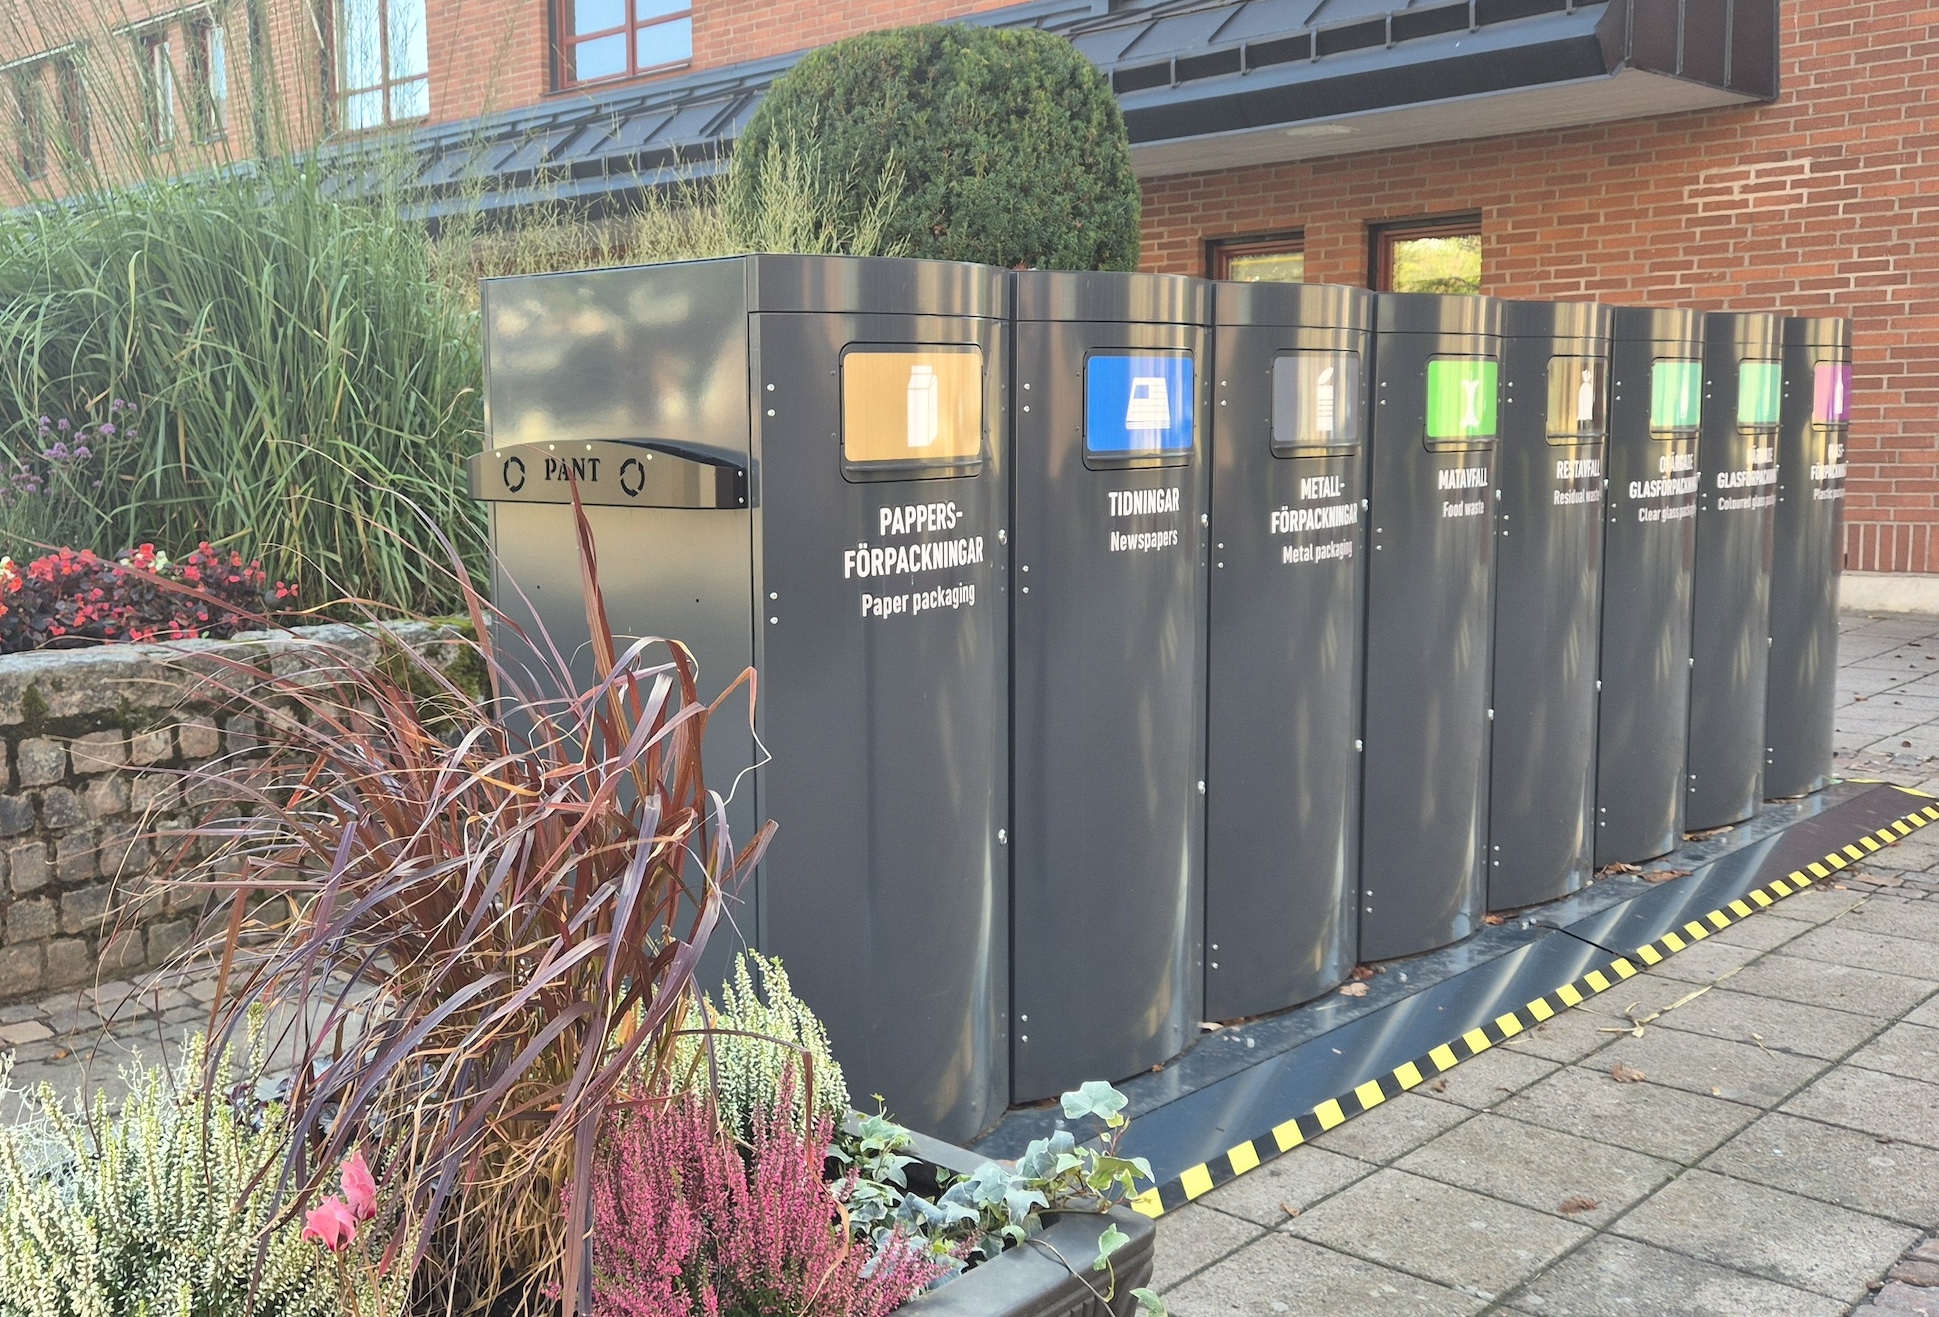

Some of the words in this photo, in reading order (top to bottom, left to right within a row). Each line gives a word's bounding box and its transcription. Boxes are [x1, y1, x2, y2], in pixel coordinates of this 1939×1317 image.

[545, 458, 600, 481] PANT
[1438, 467, 1488, 490] MATAVFALL
[1556, 459, 1600, 479] RESTAVFALL
[1301, 475, 1346, 500] METALL-
[1553, 488, 1585, 505] Residual
[1108, 487, 1180, 517] TIDNINGAR
[1442, 500, 1464, 518] Food
[1464, 499, 1485, 516] waste
[1717, 495, 1751, 511] Coloured
[880, 501, 963, 536] PAPPERS-
[1271, 503, 1358, 534] FÖRPACKNINGAR
[1638, 507, 1661, 522] Clear
[1661, 505, 1679, 523] glass
[1110, 529, 1178, 552] Newspapers
[844, 536, 984, 579] FÖRPACKNINGAR
[1283, 543, 1314, 564] Metal
[862, 594, 909, 619] Paper
[913, 582, 975, 615] packaging
